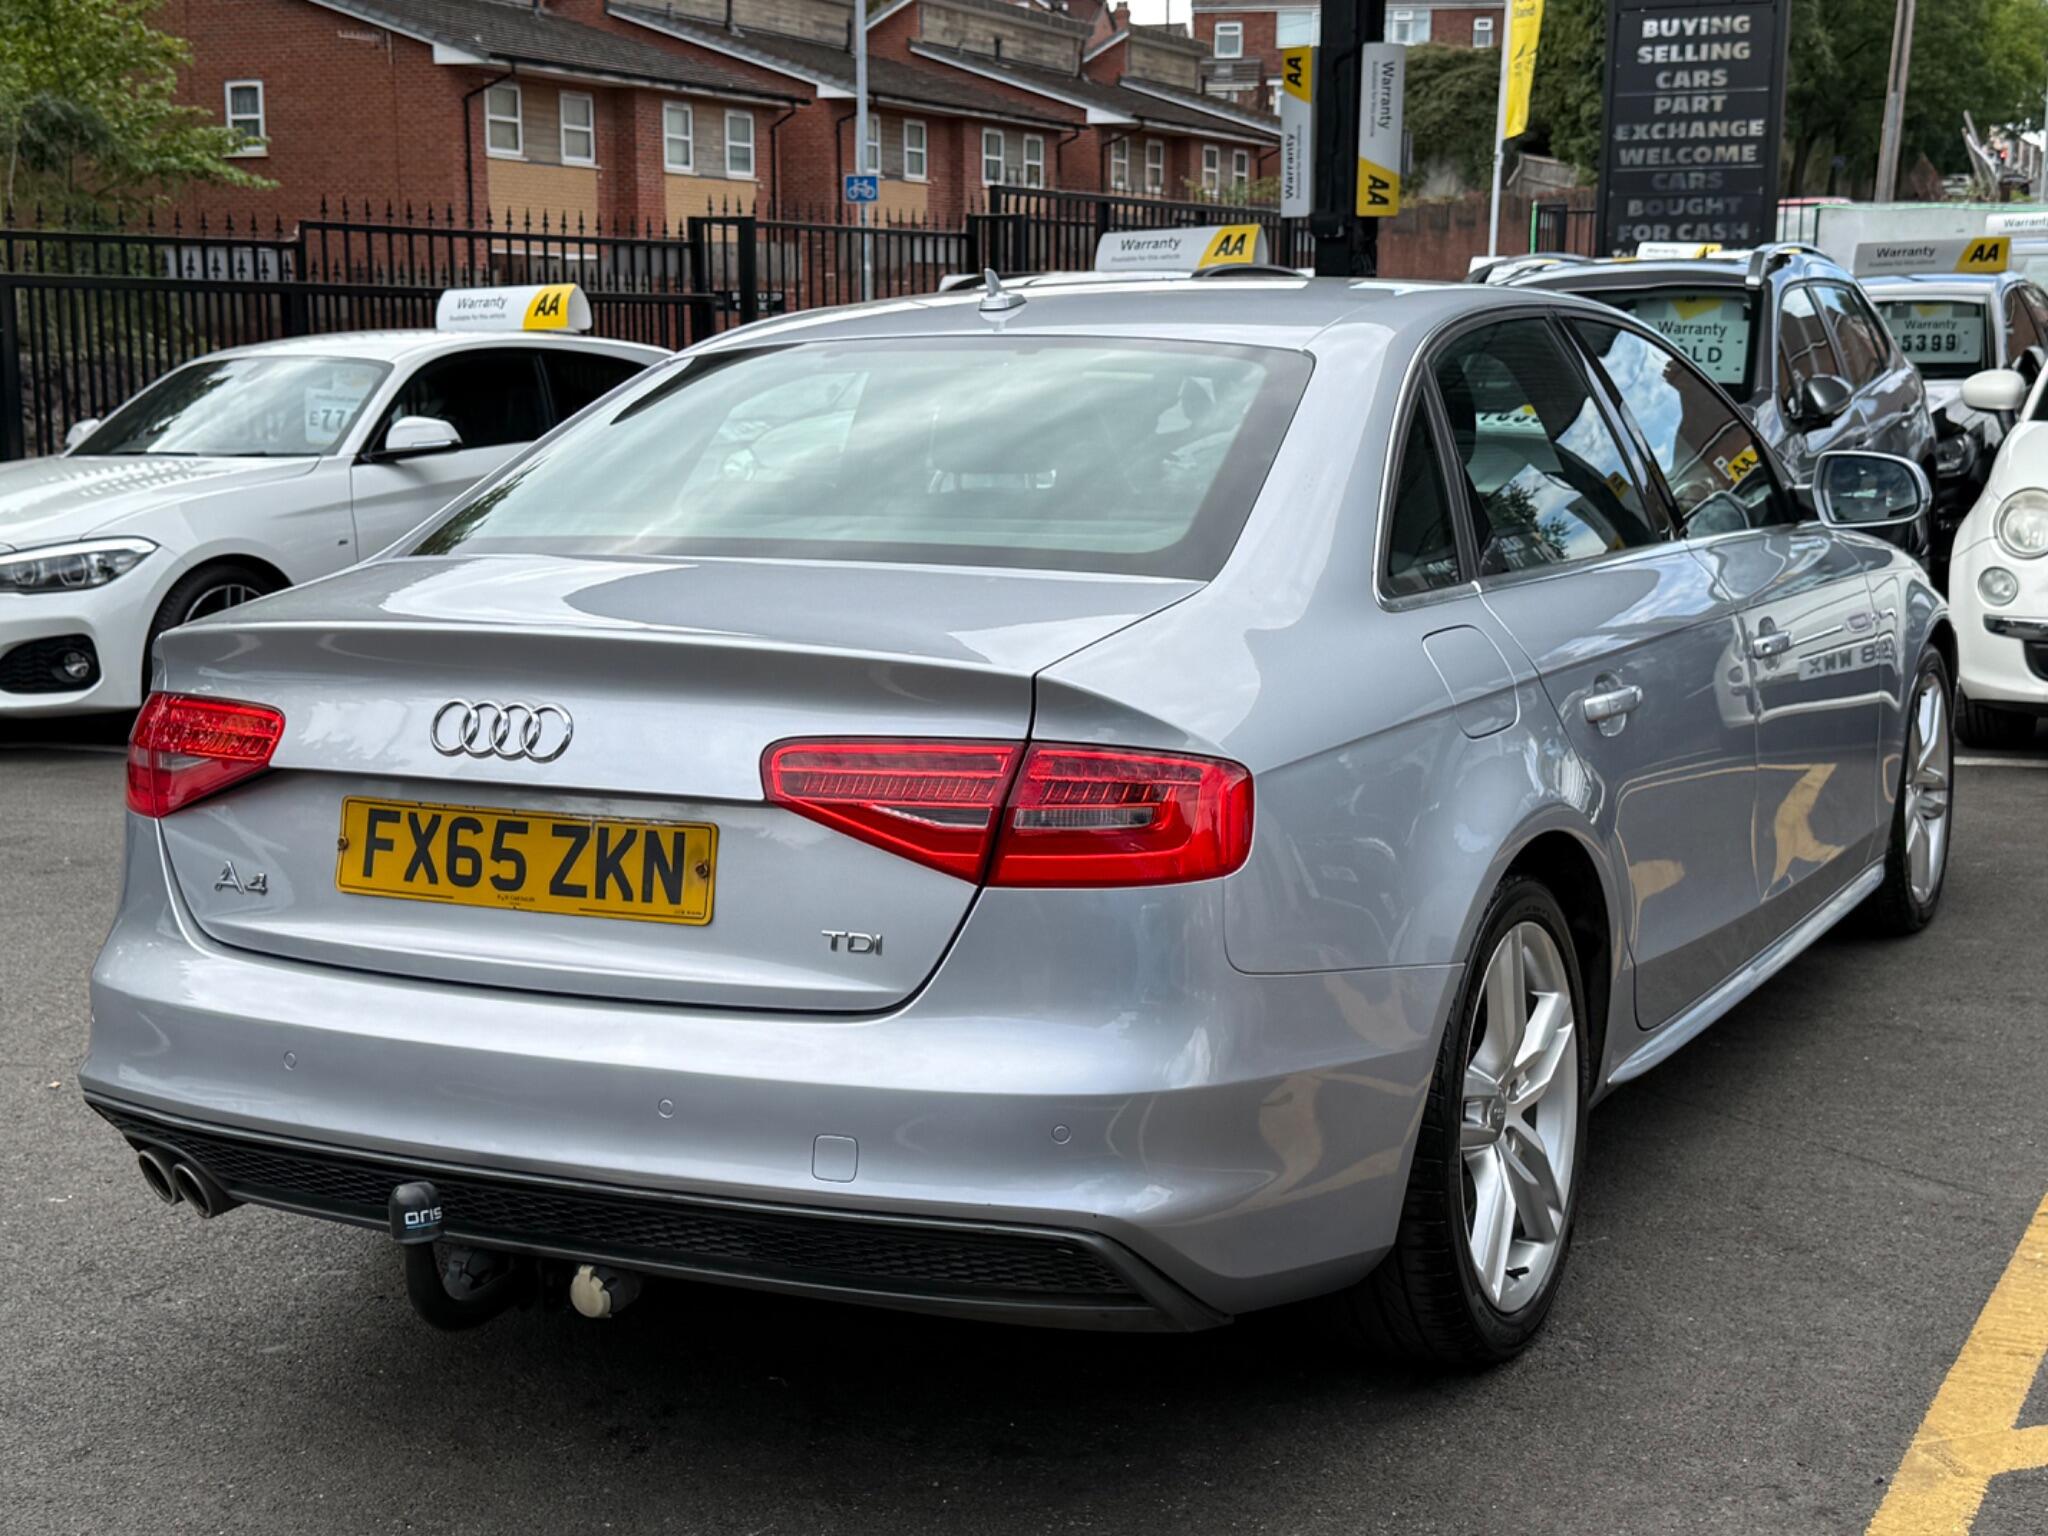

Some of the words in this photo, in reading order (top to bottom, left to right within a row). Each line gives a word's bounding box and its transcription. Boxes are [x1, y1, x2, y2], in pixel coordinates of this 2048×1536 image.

[1641, 16, 1751, 38] BUYING
[1637, 42, 1751, 64] SELLING
[1286, 56, 1302, 87] AA
[1655, 69, 1728, 89] CARS
[1377, 61, 1396, 130] Warranty
[1653, 95, 1728, 115] PART
[1614, 119, 1766, 141] EXCHANGE
[1618, 145, 1757, 166] WELCOME
[1285, 133, 1296, 200] Warranty
[1368, 174, 1390, 206] AA
[1652, 172, 1724, 191] CARS
[1626, 197, 1743, 217] BOUGHT
[1616, 224, 1671, 242] FOR
[1676, 223, 1749, 241] CASH
[2004, 217, 2048, 229] Warrant
[1120, 238, 1182, 252] Warranty
[1213, 233, 1248, 258] AA
[1876, 246, 1936, 259] Warranty
[1969, 243, 2000, 263] AA
[457, 296, 509, 310] Warranty
[534, 293, 562, 318] AA
[1658, 321, 1728, 338] Warranty
[1904, 320, 1958, 330] Warranty
[362, 807, 529, 892] FX65
[549, 824, 686, 906] ZKN
[214, 860, 268, 896] A4
[821, 929, 883, 956] TDI
